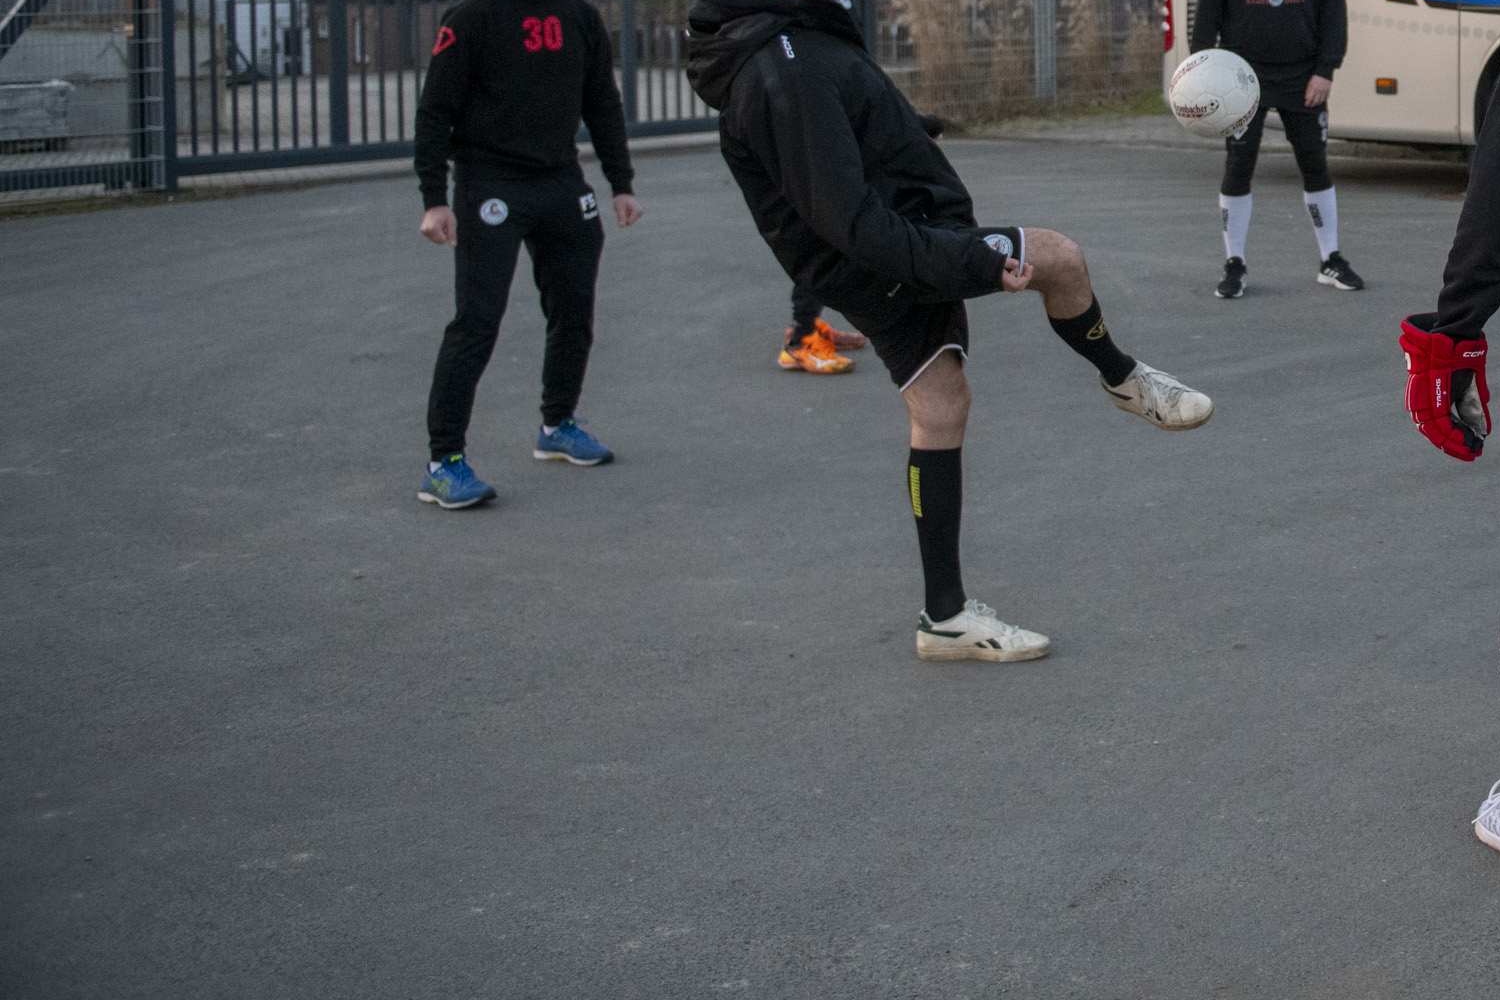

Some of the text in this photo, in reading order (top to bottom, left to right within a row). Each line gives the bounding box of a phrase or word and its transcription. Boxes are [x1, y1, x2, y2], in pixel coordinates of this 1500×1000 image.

[522, 15, 563, 52] 30
[780, 35, 795, 59] CCM
[1462, 349, 1485, 357] CCM
